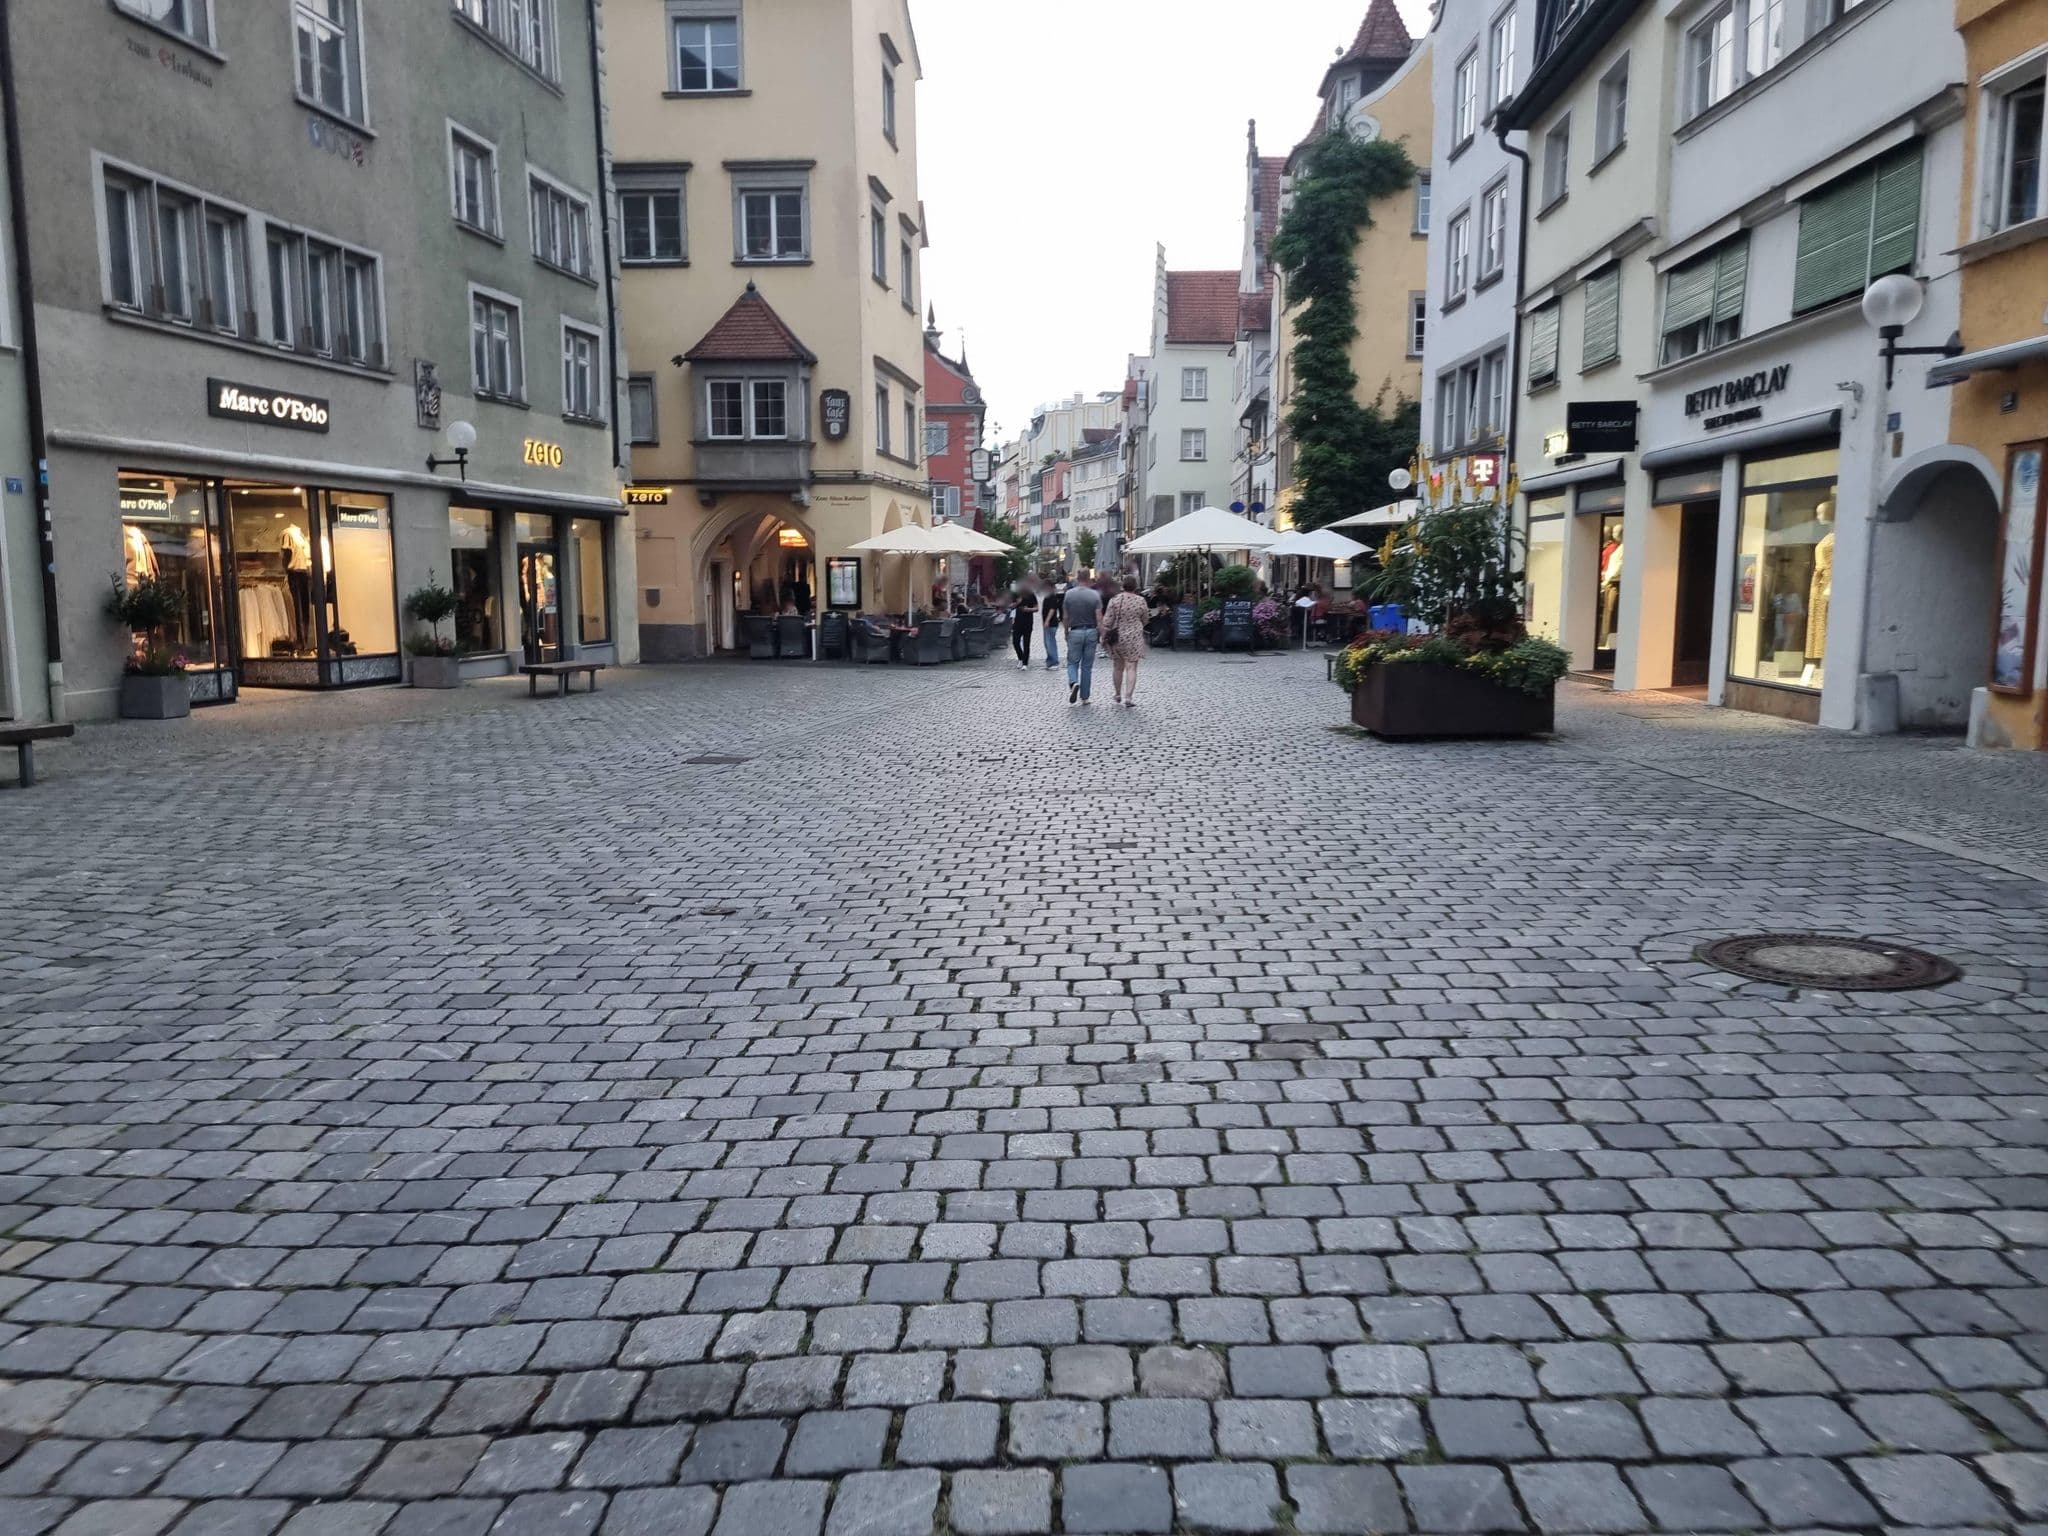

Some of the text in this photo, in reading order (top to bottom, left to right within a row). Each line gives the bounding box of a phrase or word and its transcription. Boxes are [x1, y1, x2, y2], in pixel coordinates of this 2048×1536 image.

[1685, 363, 1791, 417] BETTY BARCLAY
[219, 386, 328, 424] Marc O'Polo
[1571, 420, 1633, 429] BETTY BARCLAY
[524, 439, 563, 468] zero
[1473, 459, 1494, 482] T
[120, 498, 168, 511] arc O'Polo
[631, 492, 663, 503] zero
